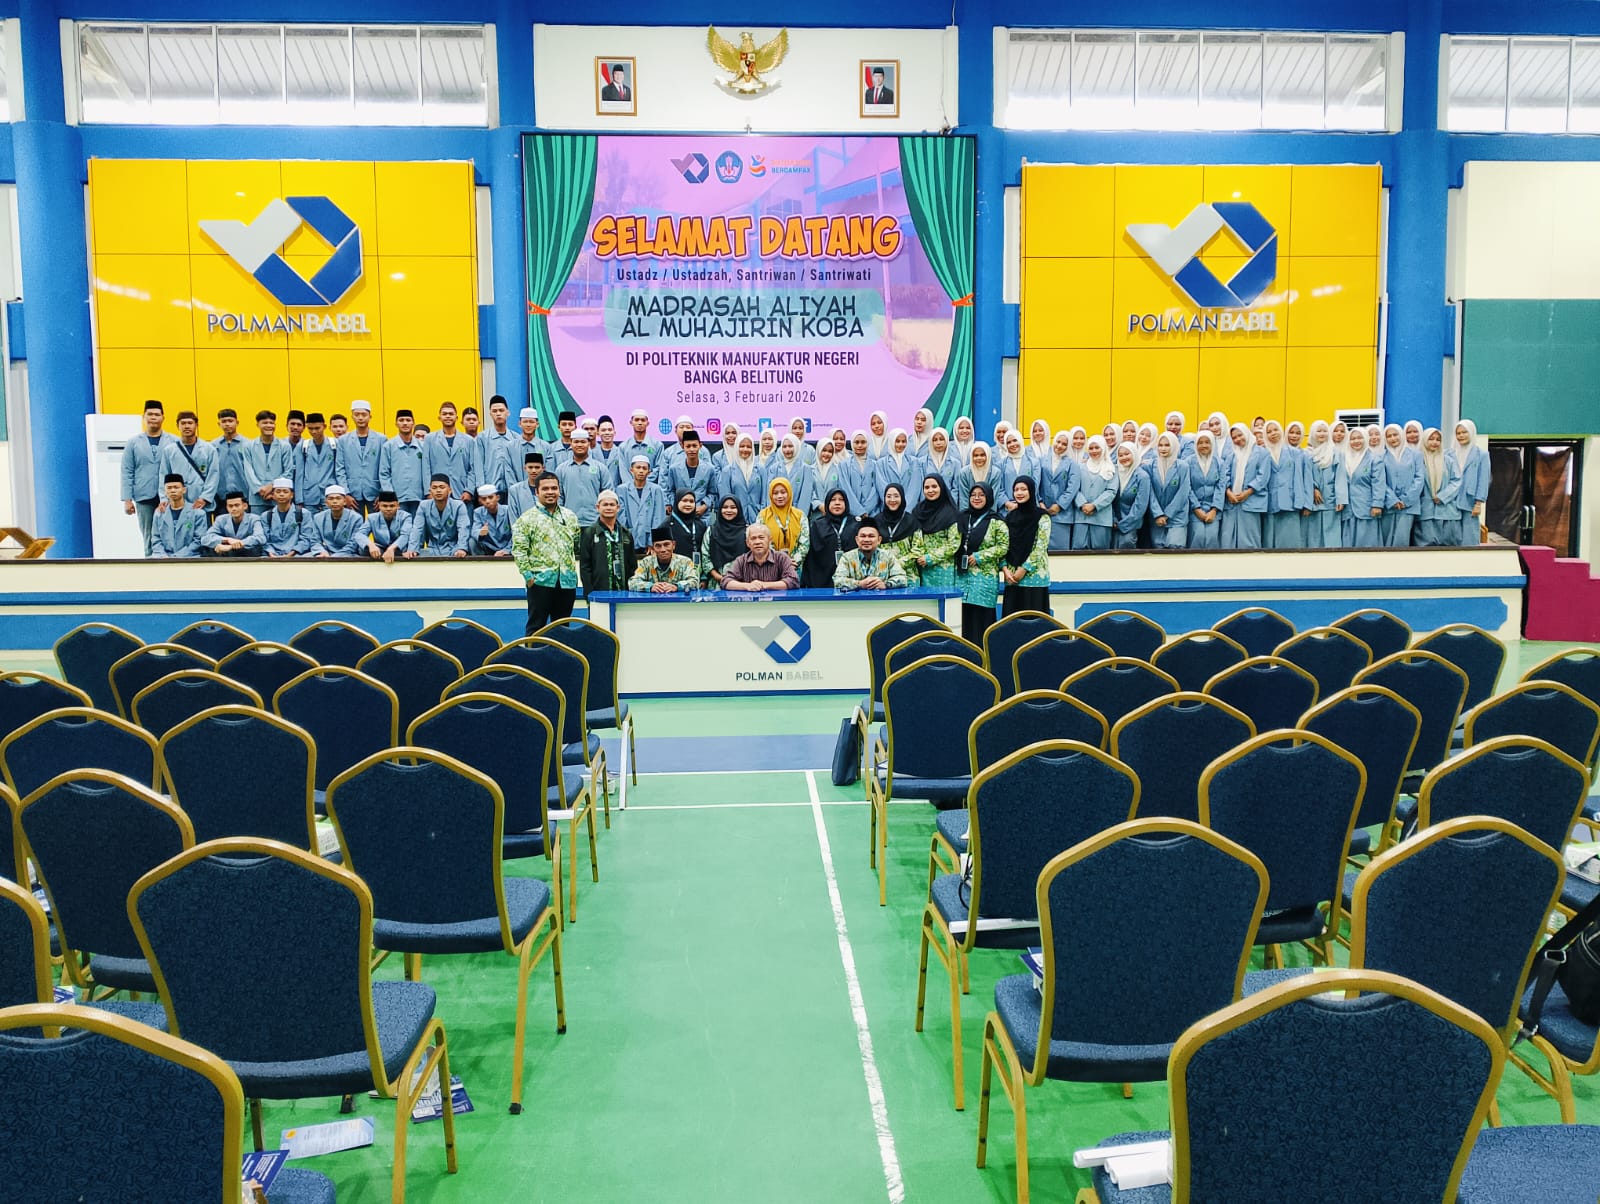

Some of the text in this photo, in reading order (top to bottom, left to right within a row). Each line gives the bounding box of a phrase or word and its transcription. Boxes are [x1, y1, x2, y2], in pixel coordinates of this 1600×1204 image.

[592, 215, 901, 257] SELAMAT DATANG
[617, 268, 658, 281] Ustadz
[672, 268, 732, 283] Ustadzah,
[736, 268, 796, 281] Santriwan
[810, 268, 871, 281] Santriwati
[627, 295, 856, 317] MADRASAH ALIYAH
[621, 317, 864, 338] AL MUHAJIRIN KOBA
[626, 352, 859, 366] DI POLITEKNIK MANUFAKTUR NEGERI
[684, 370, 803, 384] BANGKA BELITUNG
[676, 390, 816, 404] Selasa, 3 Februari 2026
[736, 671, 823, 680] POLMAN BABEL
